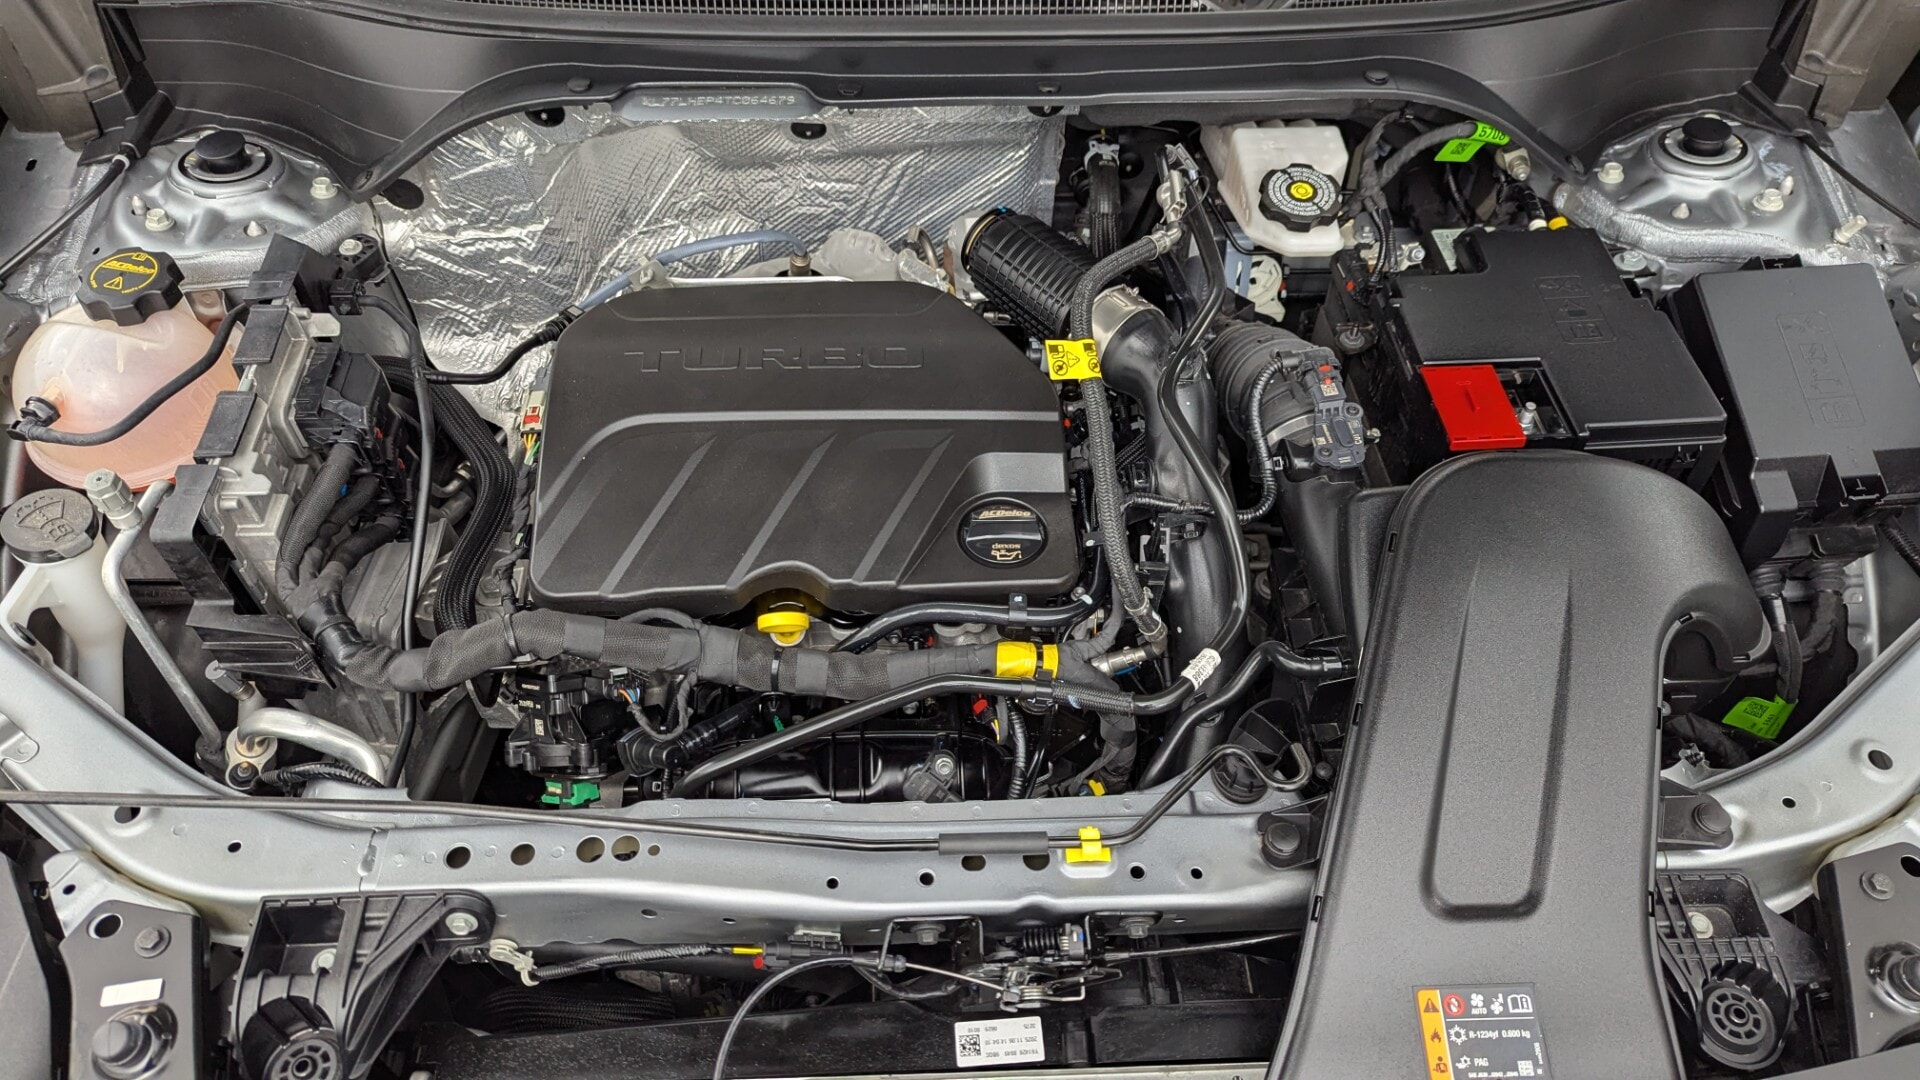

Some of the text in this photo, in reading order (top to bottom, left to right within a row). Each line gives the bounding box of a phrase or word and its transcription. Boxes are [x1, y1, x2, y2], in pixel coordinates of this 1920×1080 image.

[102, 260, 156, 275] ACDelco
[623, 344, 925, 373] TURBO
[979, 509, 1031, 519] ACDelco
[1471, 1007, 1488, 1015] AUTO
[1469, 1030, 1499, 1040] R-1234yf
[1521, 1029, 1531, 1039] kg
[1474, 1057, 1489, 1066] PAG
